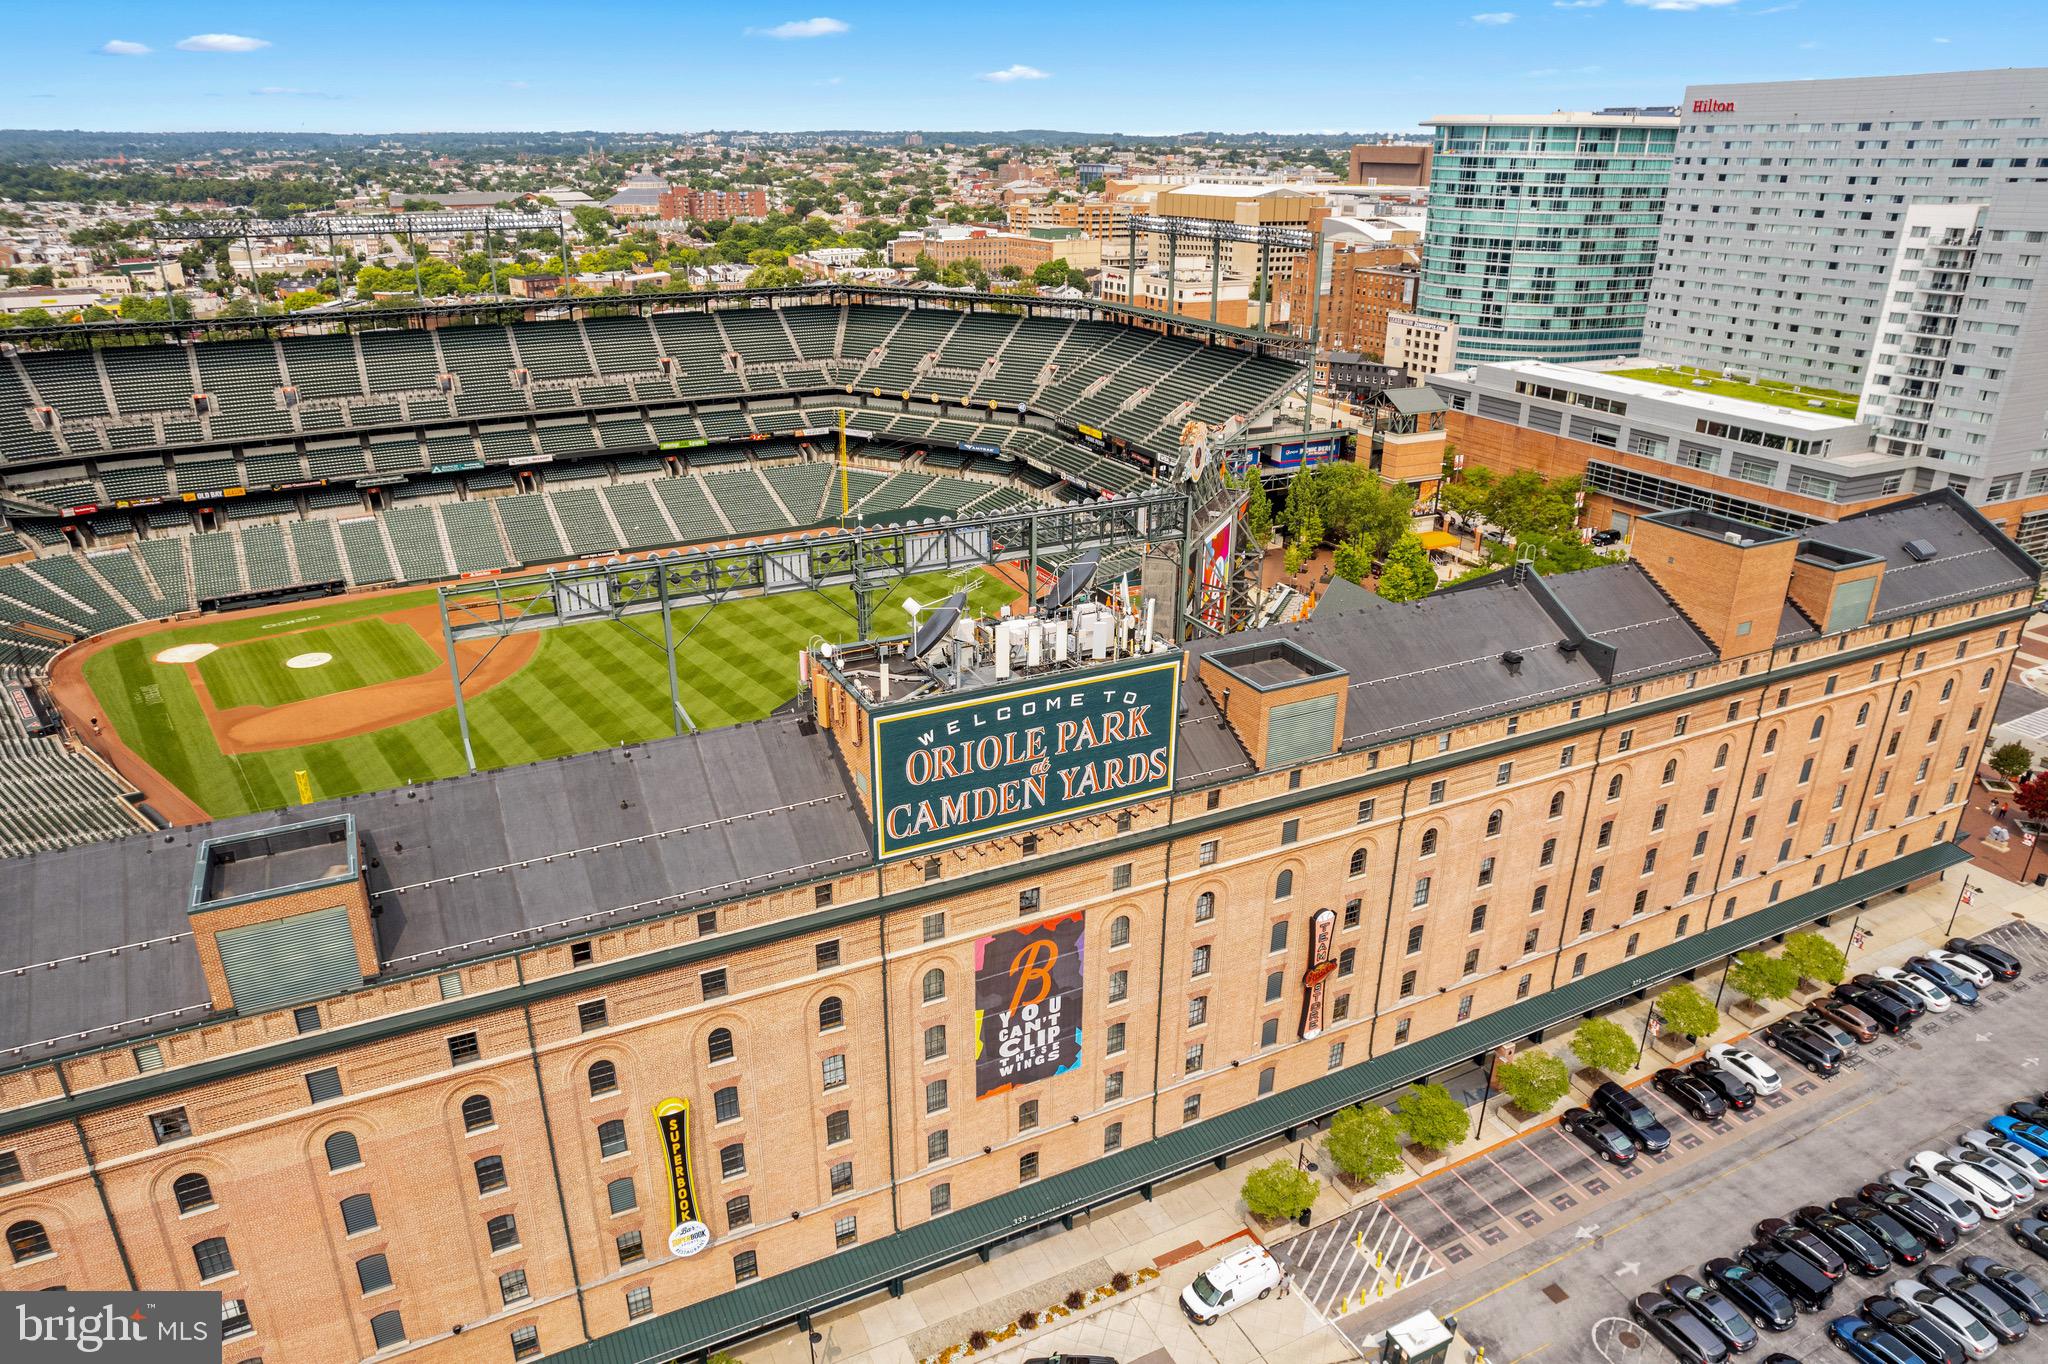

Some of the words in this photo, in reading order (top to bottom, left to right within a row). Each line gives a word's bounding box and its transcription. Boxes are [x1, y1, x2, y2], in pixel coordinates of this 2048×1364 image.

[1693, 99, 1735, 113] Hilton
[196, 492, 210, 500] OLD
[210, 490, 223, 498] BAY
[917, 693, 1085, 746] WELCOME
[1103, 690, 1137, 705] TO
[906, 726, 1047, 786] ORIOLE
[1055, 704, 1151, 756] PARK
[1030, 757, 1052, 776] at
[887, 773, 1046, 839] CAMDEN
[1057, 747, 1168, 800] YARDS
[1317, 922, 1330, 961] TEAM
[1009, 939, 1059, 1018] B
[998, 1013, 1061, 1042] CAN'T
[999, 996, 1061, 1029] YOU
[998, 1025, 1061, 1058] CLIP
[999, 1043, 1060, 1067] THESE
[999, 1051, 1060, 1077] WINGS
[669, 1119, 691, 1221] SUPERBOOK
[1012, 1215, 1027, 1226] 333
